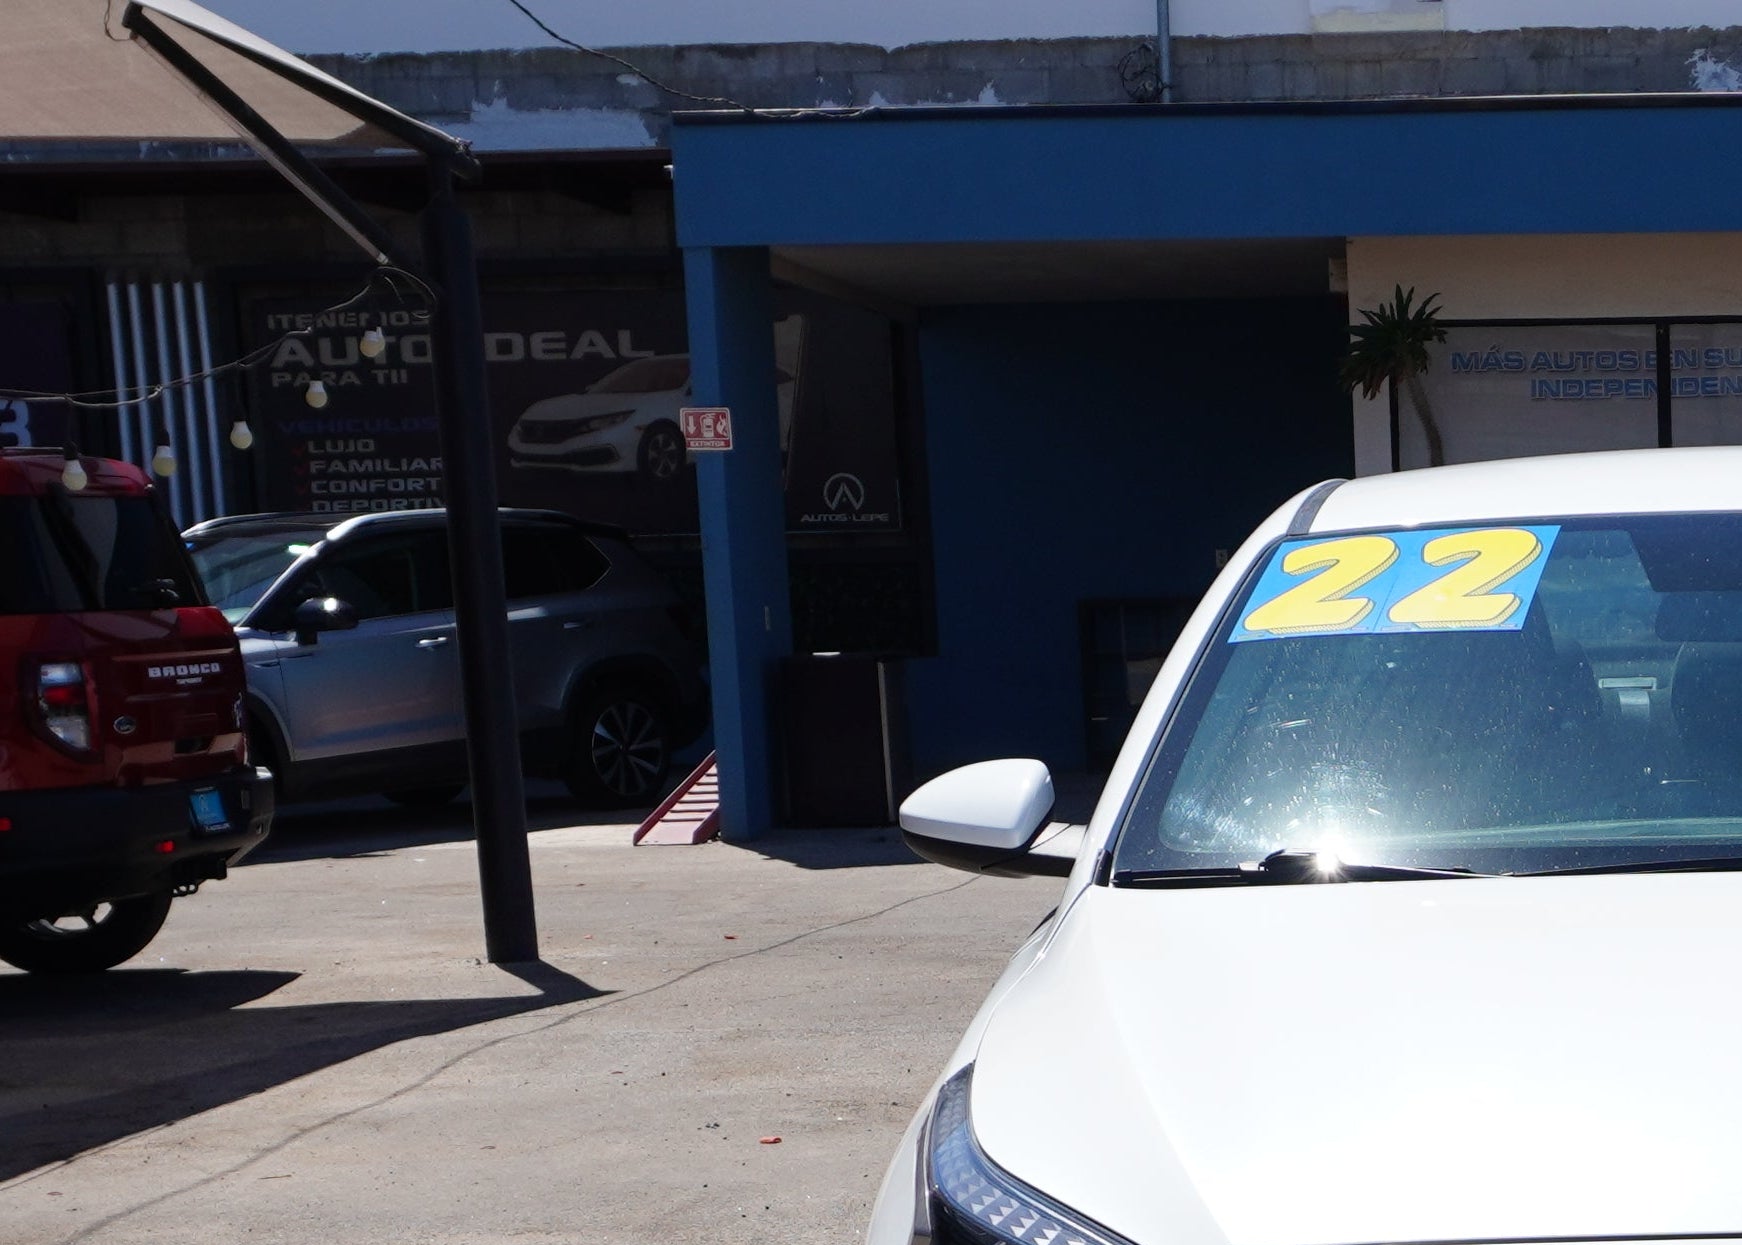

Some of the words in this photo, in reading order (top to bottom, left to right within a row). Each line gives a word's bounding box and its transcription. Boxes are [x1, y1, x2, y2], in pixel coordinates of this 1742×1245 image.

[1451, 345, 1525, 372] MÁS
[1530, 349, 1640, 371] AUTOS
[307, 438, 376, 453] LUJO
[148, 662, 221, 678] BRONCO
